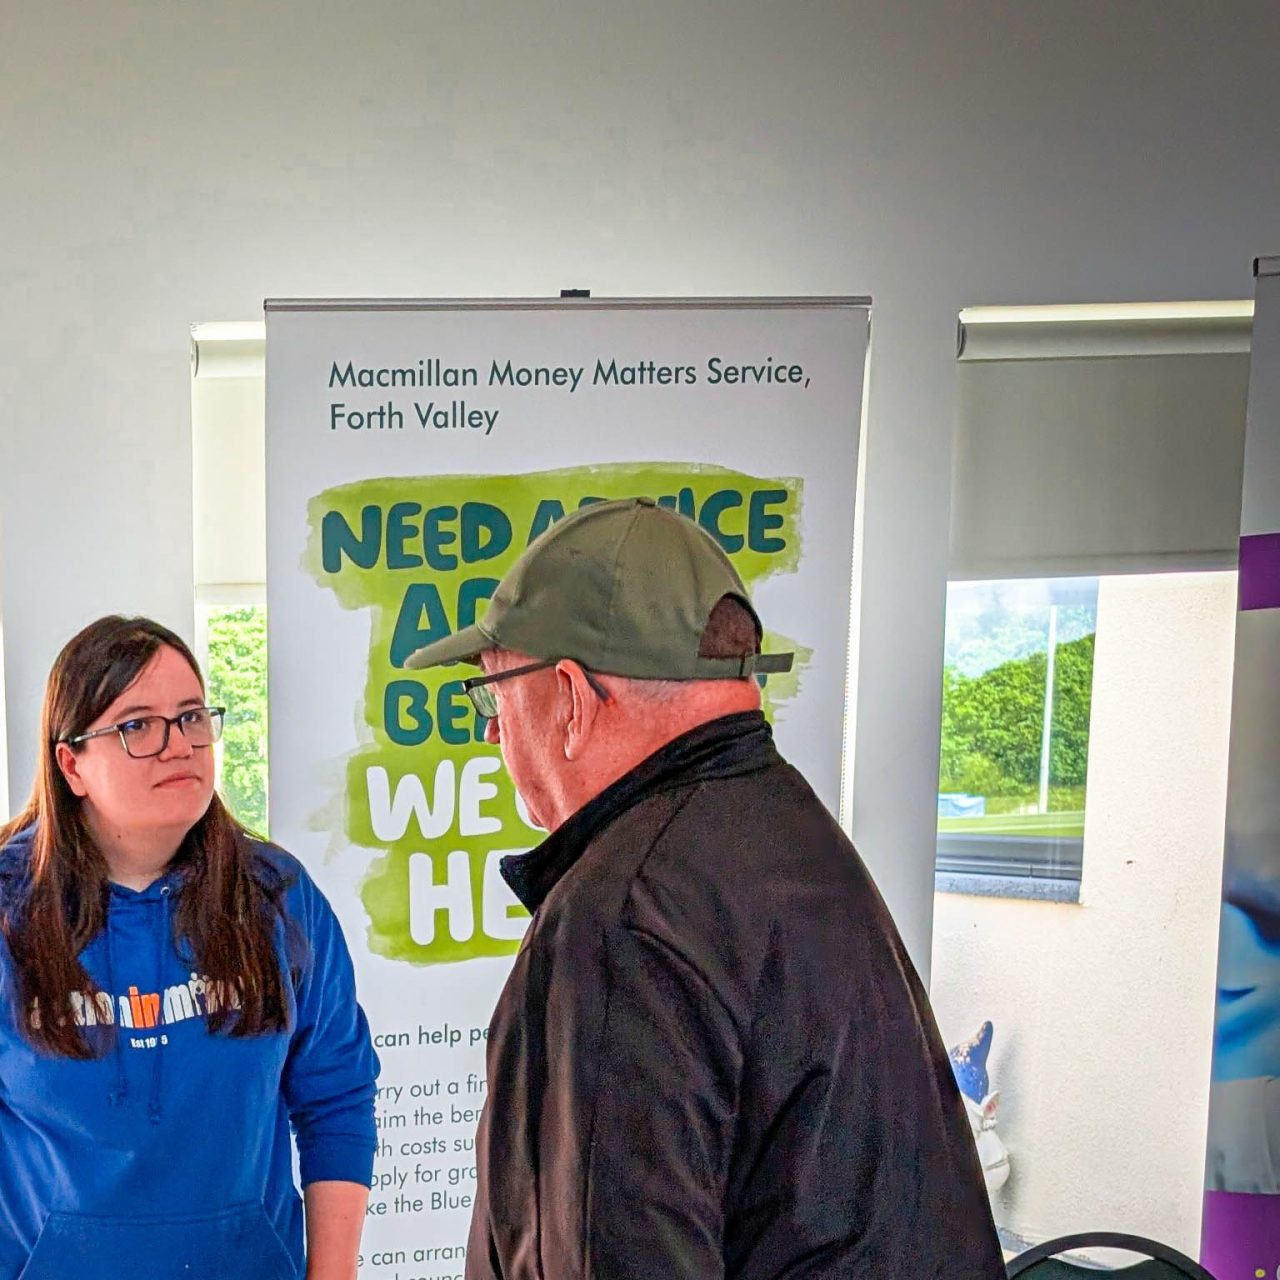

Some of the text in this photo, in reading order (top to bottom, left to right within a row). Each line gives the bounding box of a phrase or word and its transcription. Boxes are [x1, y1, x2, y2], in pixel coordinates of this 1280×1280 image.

[329, 357, 811, 392] Macmillan Money Matters Service,
[331, 400, 499, 435] Forth Valley
[322, 501, 512, 573] NEED
[374, 1023, 462, 1048] can help
[410, 1079, 459, 1098] out a
[414, 1106, 443, 1126] the
[400, 1136, 446, 1156] costs
[414, 1163, 441, 1183] for
[394, 1190, 472, 1214] the Blue
[371, 1250, 406, 1266] can
